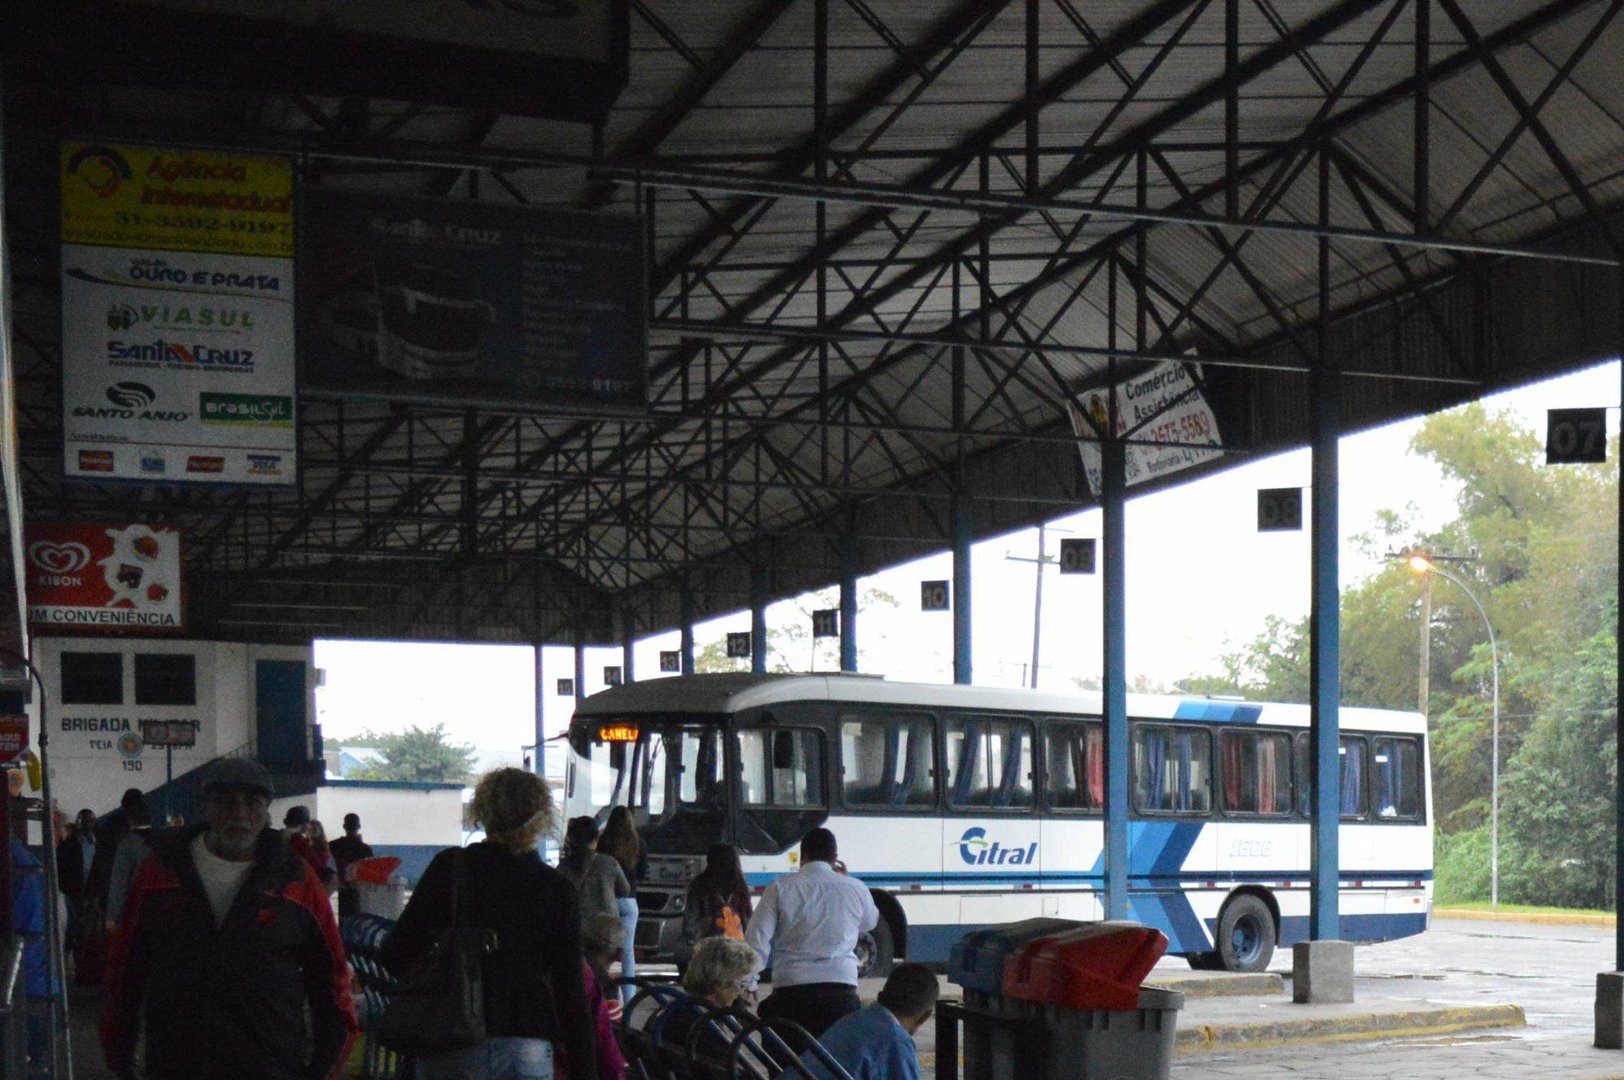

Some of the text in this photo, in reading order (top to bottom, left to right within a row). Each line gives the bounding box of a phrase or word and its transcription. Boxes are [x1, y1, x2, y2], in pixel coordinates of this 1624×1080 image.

[129, 266, 280, 291] OURO E PRATA
[141, 305, 253, 328] VIASUL
[1125, 362, 1187, 401] Comércio
[71, 407, 189, 422] SANTO ANJO
[1551, 421, 1601, 456] 07
[39, 575, 82, 587] KIBON
[924, 586, 946, 607] 10
[817, 616, 833, 634] 11
[730, 637, 748, 655] 12
[62, 718, 131, 732] BRIGADA
[122, 760, 142, 771] 190
[960, 826, 1038, 865] Citral
